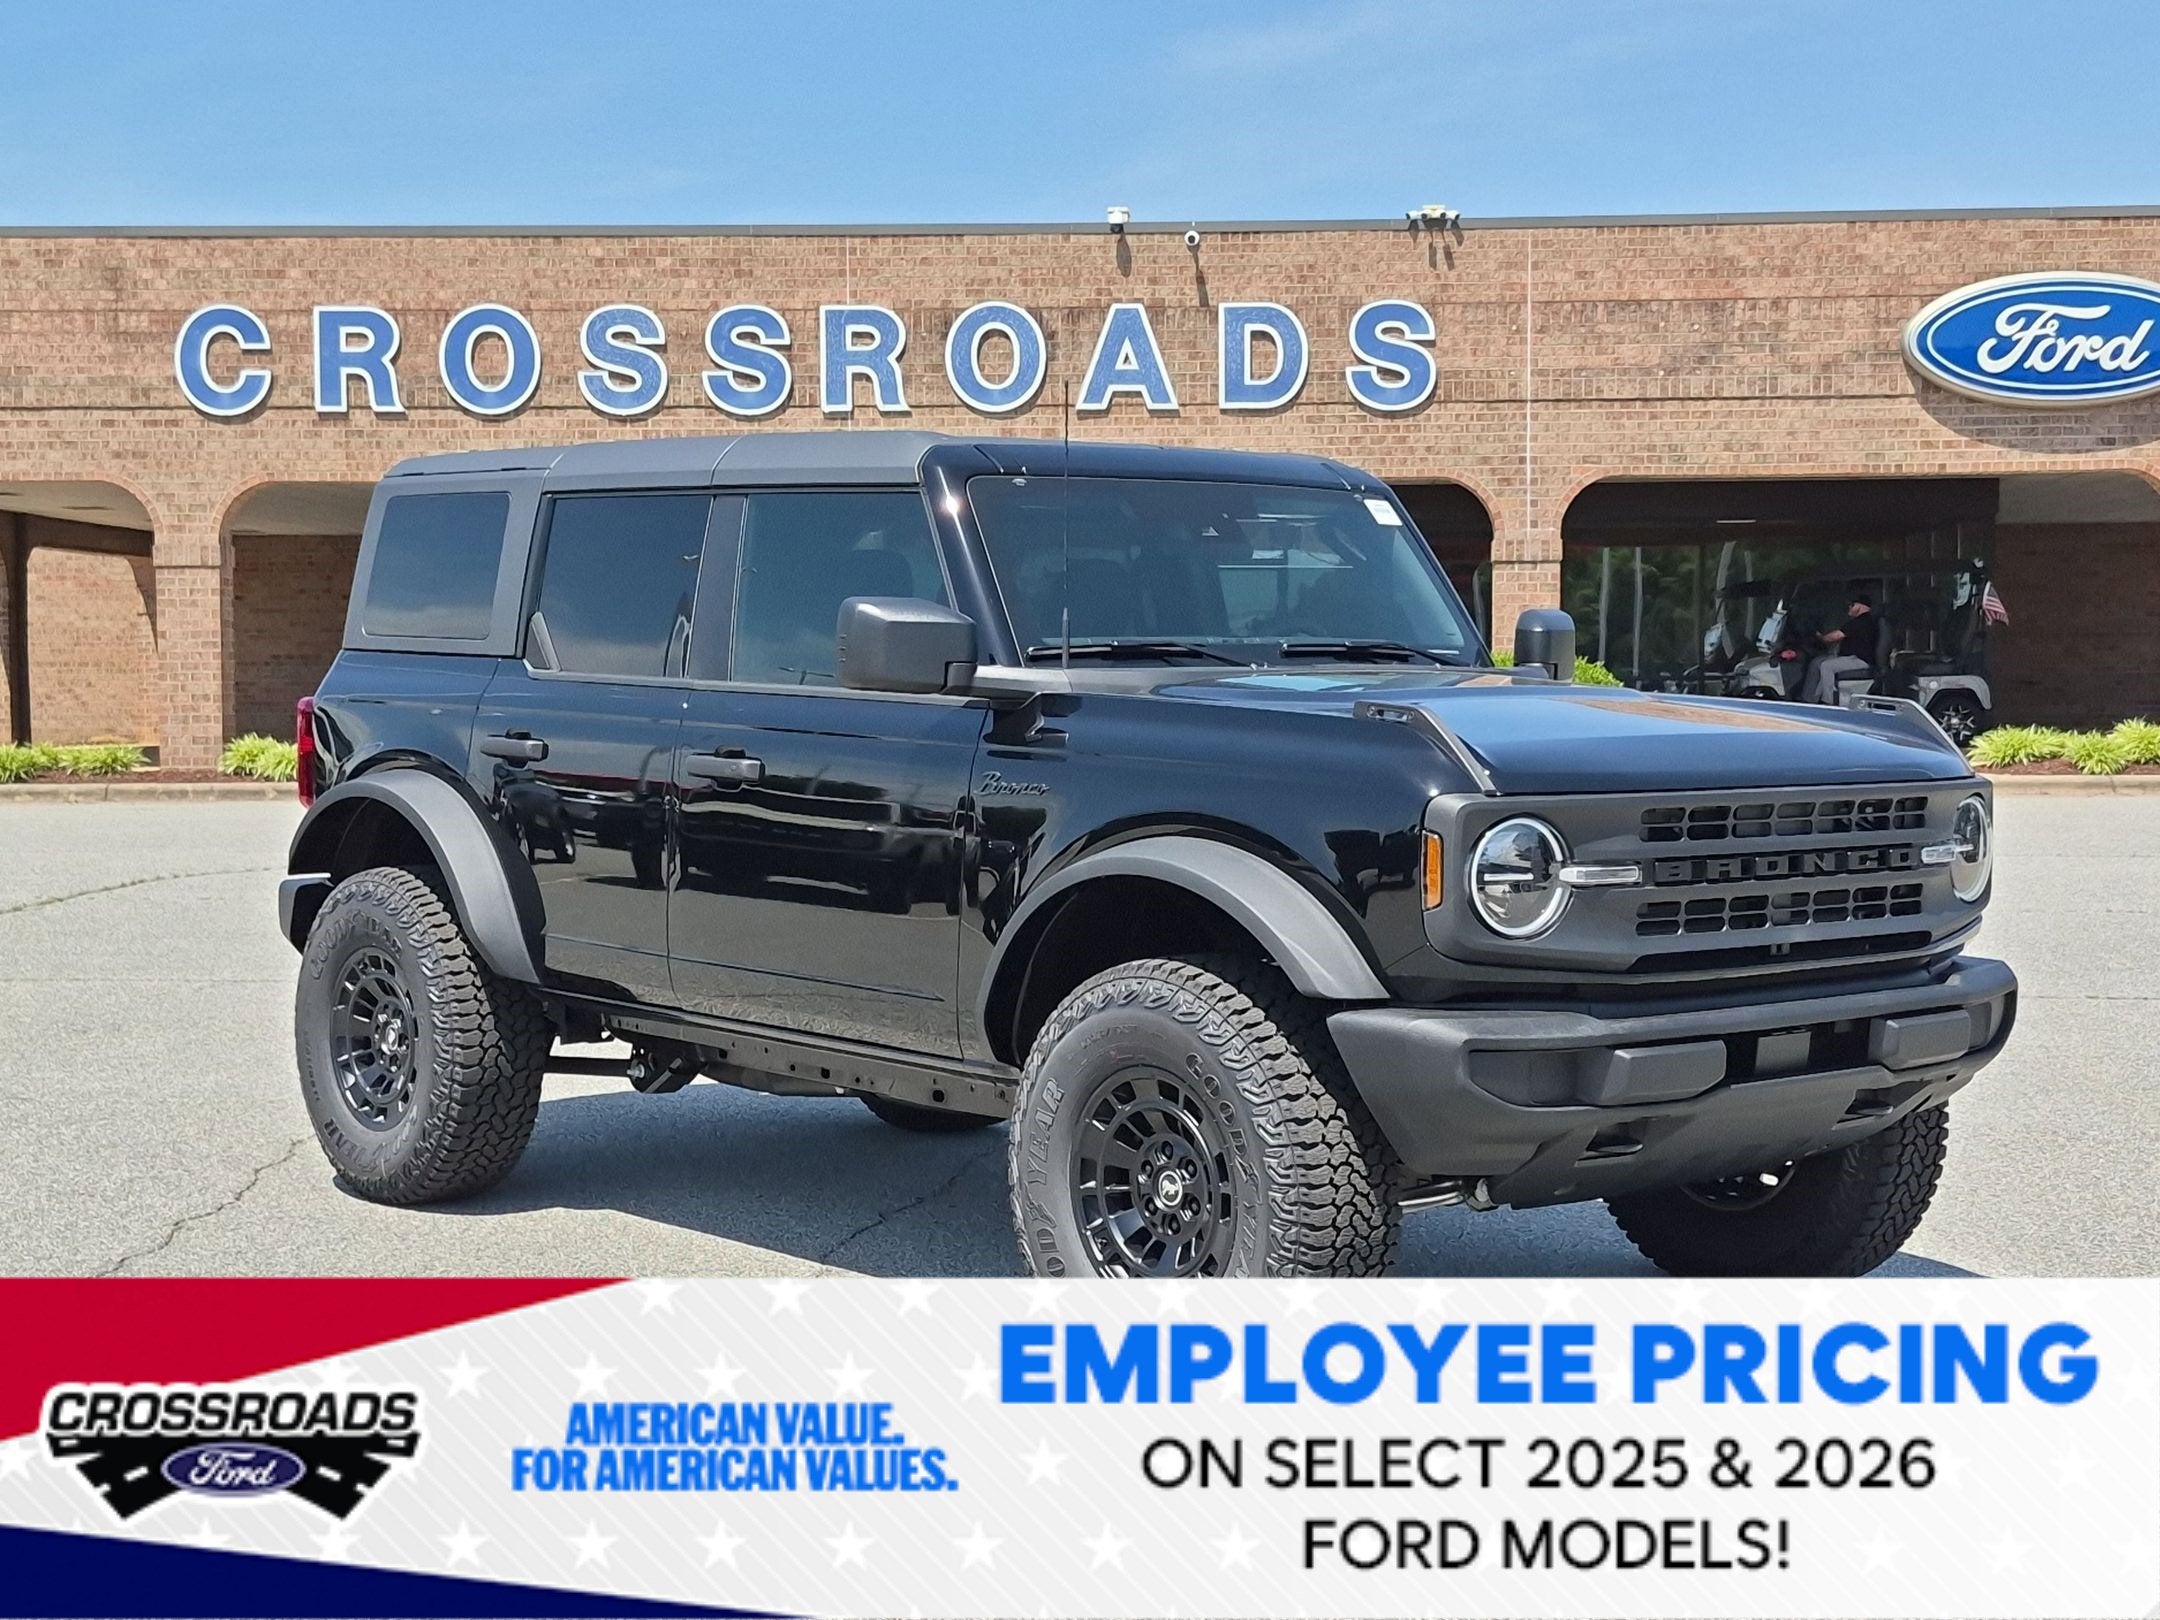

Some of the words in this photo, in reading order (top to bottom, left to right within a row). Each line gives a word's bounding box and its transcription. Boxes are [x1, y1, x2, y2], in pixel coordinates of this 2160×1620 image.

[174, 299, 1437, 417] CROSSROADS
[1976, 302, 2155, 374] Ford
[973, 770, 1051, 798] Bronco
[1653, 848, 1915, 884] BRONCO
